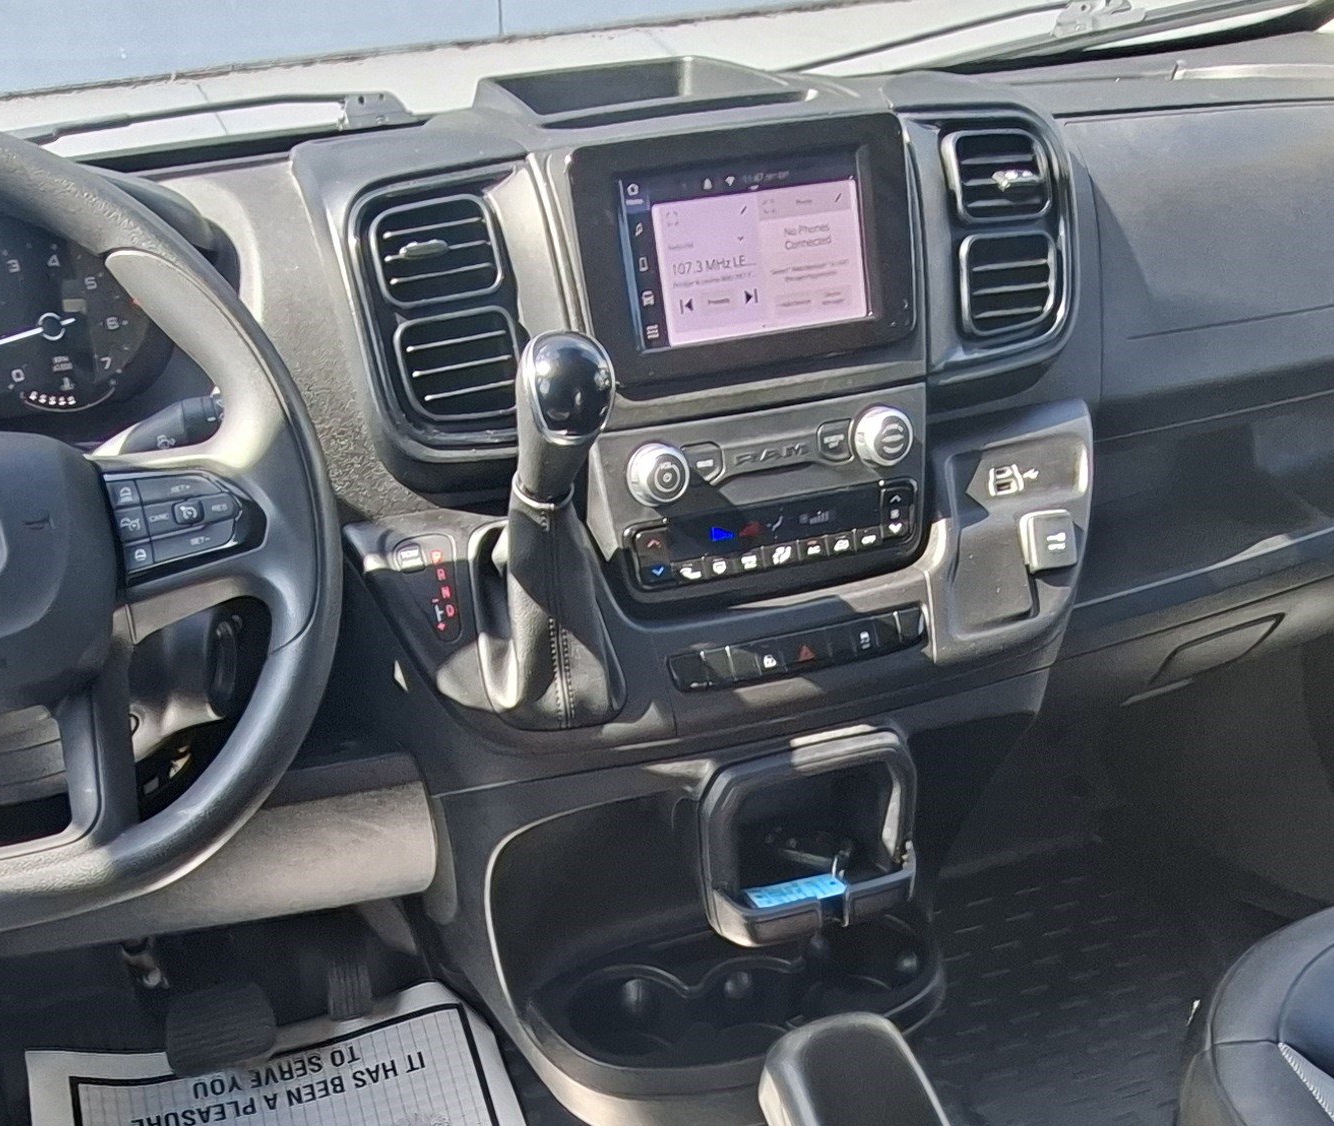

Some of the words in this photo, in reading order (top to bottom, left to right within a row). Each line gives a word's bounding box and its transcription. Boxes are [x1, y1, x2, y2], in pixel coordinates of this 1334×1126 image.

[785, 235, 832, 250] Connected
[6, 259, 21, 273] 3
[47, 255, 61, 267] 4
[673, 260, 703, 275] 107.3
[706, 258, 730, 271] MHz
[84, 276, 97, 290] 5
[105, 316, 120, 330] 6
[100, 356, 112, 370] 7
[11, 368, 25, 383] 0
[734, 442, 809, 466] RAM
[445, 604, 456, 617] D
[330, 1045, 361, 1067] TO
[405, 1051, 426, 1073] IT
[250, 1053, 323, 1089] SERVE
[352, 1059, 398, 1088] HAS
[192, 1074, 242, 1100] YOU
[286, 1075, 346, 1107] BEEN
[263, 1093, 278, 1110] A
